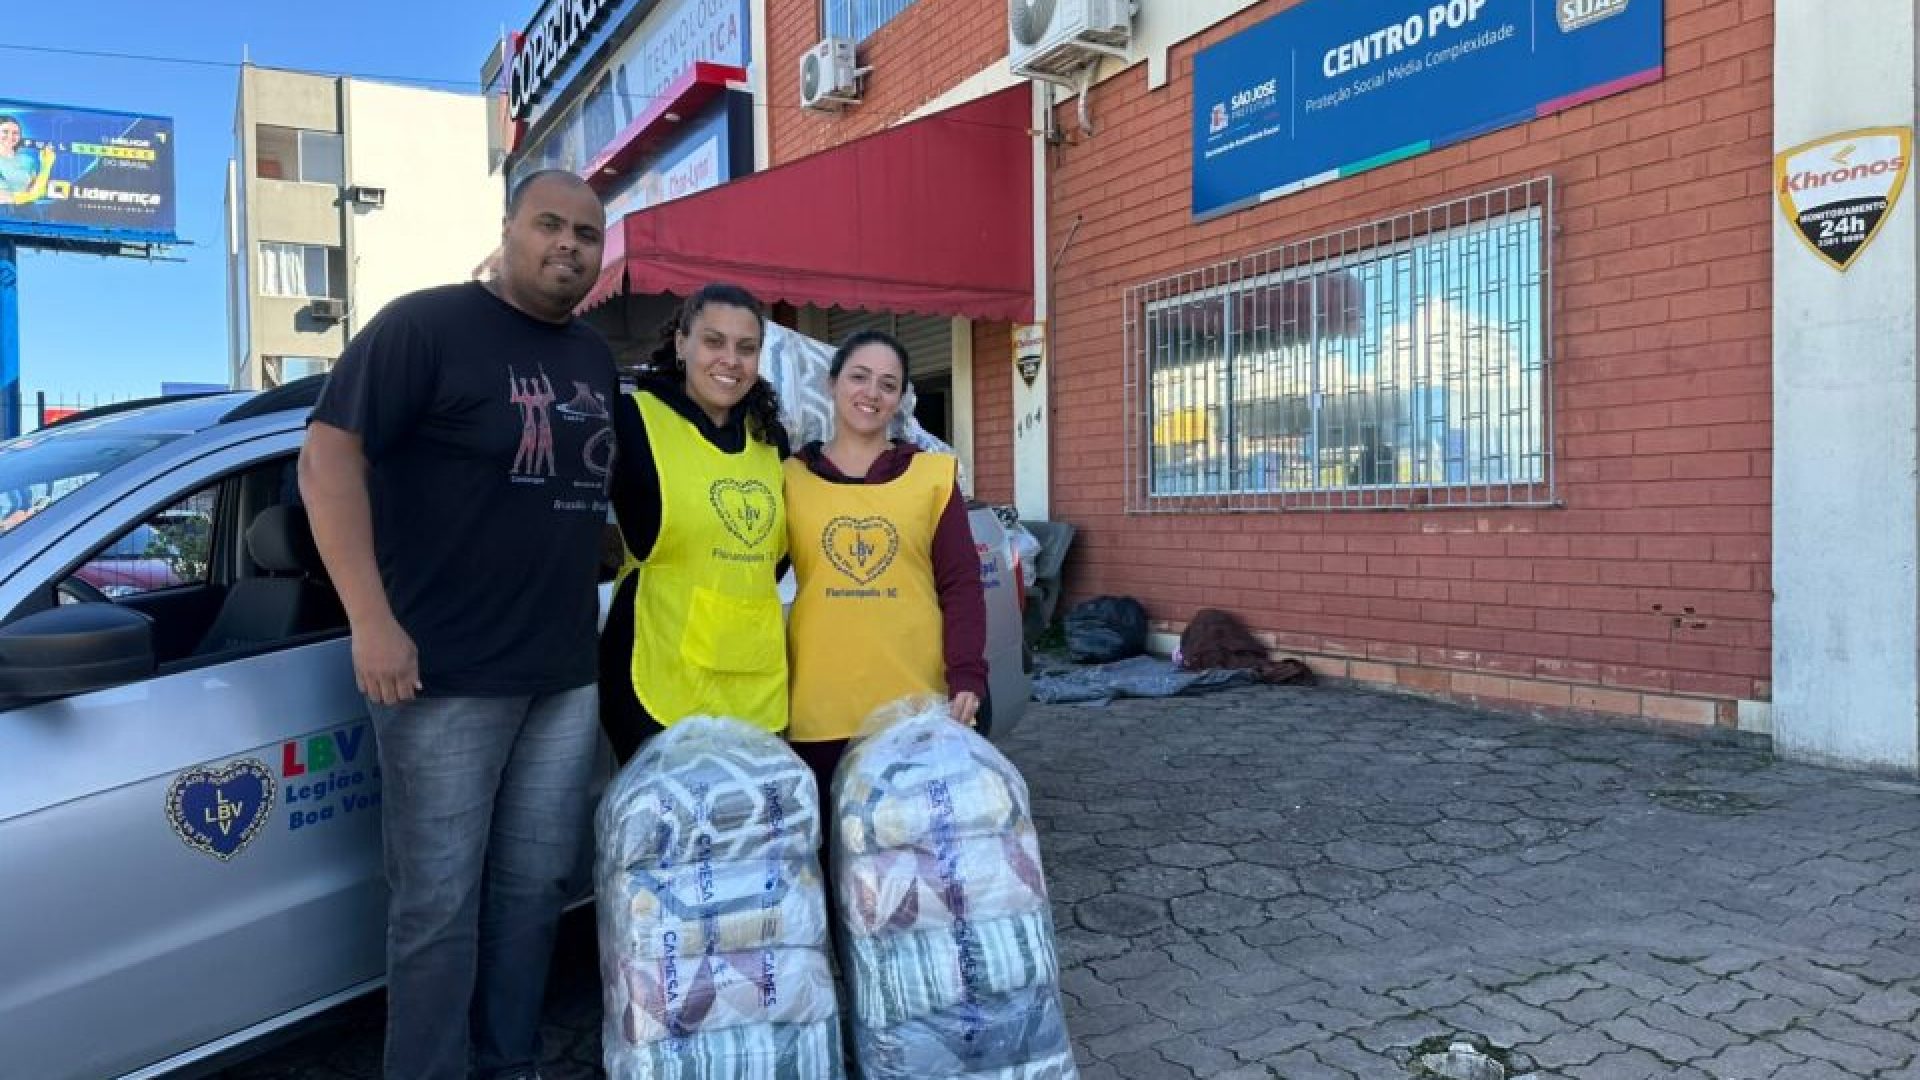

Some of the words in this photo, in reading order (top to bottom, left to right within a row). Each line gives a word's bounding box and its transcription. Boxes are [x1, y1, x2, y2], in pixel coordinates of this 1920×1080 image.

[1322, 13, 1424, 78] CENTRO
[1428, 0, 1486, 37] POP
[1305, 86, 1352, 114] Proteção
[1353, 70, 1385, 98] Social
[1387, 58, 1423, 84] Média
[1425, 22, 1515, 69] Complexidade
[1781, 155, 1905, 193] Khronos
[74, 187, 161, 207] Liderança
[1799, 201, 1887, 223] MONITORAMENTO
[1819, 215, 1866, 238] 24h
[283, 727, 364, 777] LBV
[205, 800, 242, 822] LBV
[288, 804, 335, 830] Boa
[698, 833, 715, 902] CAMESA
[662, 931, 680, 1003] CAMESA
[761, 952, 777, 1009] CAMES
